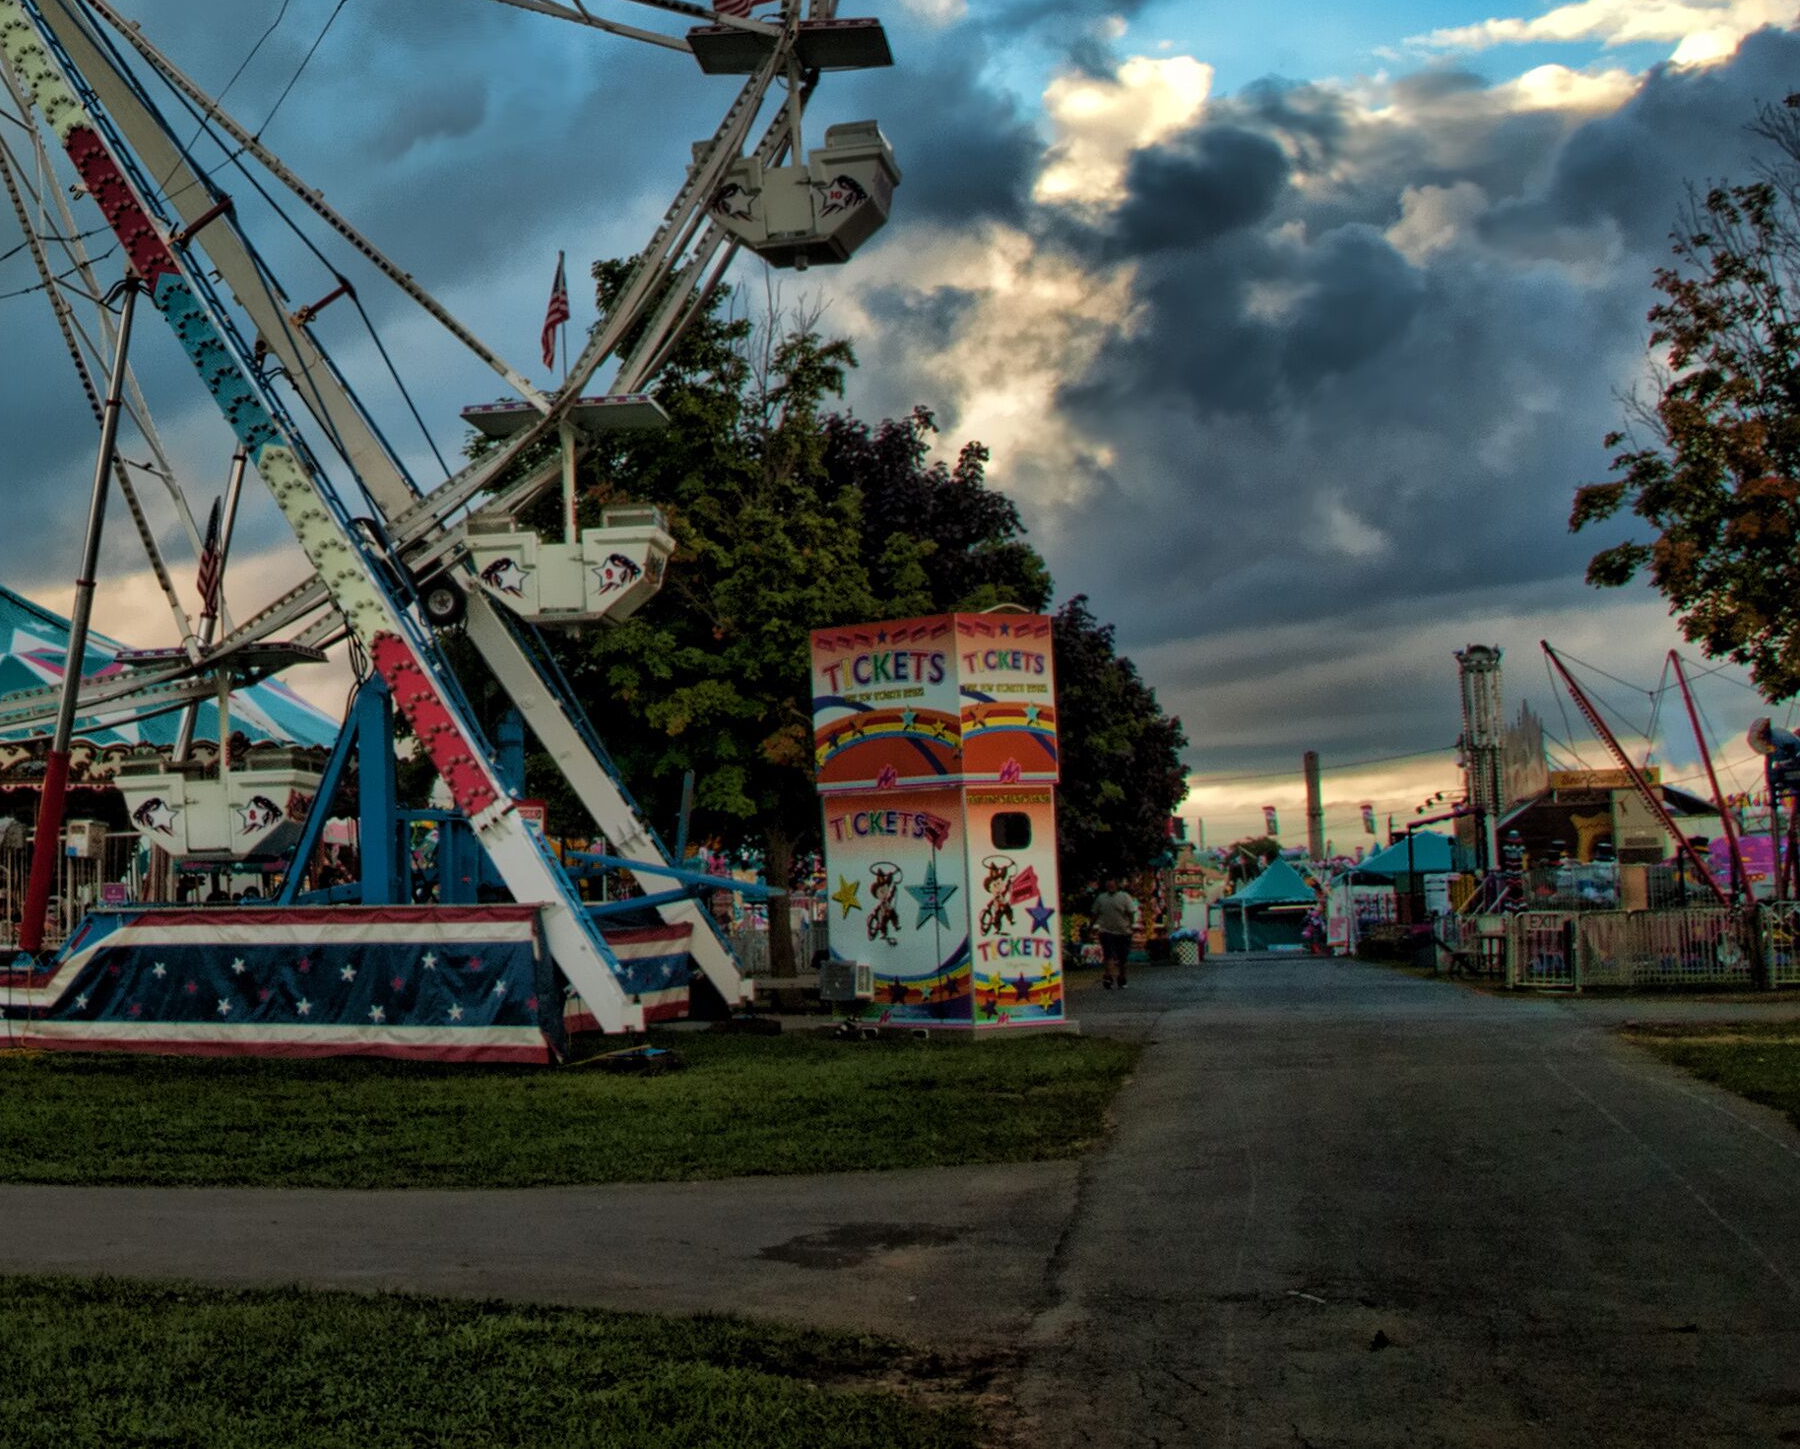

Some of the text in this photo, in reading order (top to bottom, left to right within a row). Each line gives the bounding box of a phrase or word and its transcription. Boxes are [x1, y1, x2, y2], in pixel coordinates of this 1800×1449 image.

[830, 190, 842, 200] 10
[605, 567, 614, 580] 9
[963, 648, 1045, 675] TICKETS
[823, 650, 945, 694] TICKETS
[247, 809, 258, 822] 8
[829, 809, 929, 841] TICKETS
[1530, 915, 1560, 929] EXIT
[977, 937, 1053, 962] TICKETS
